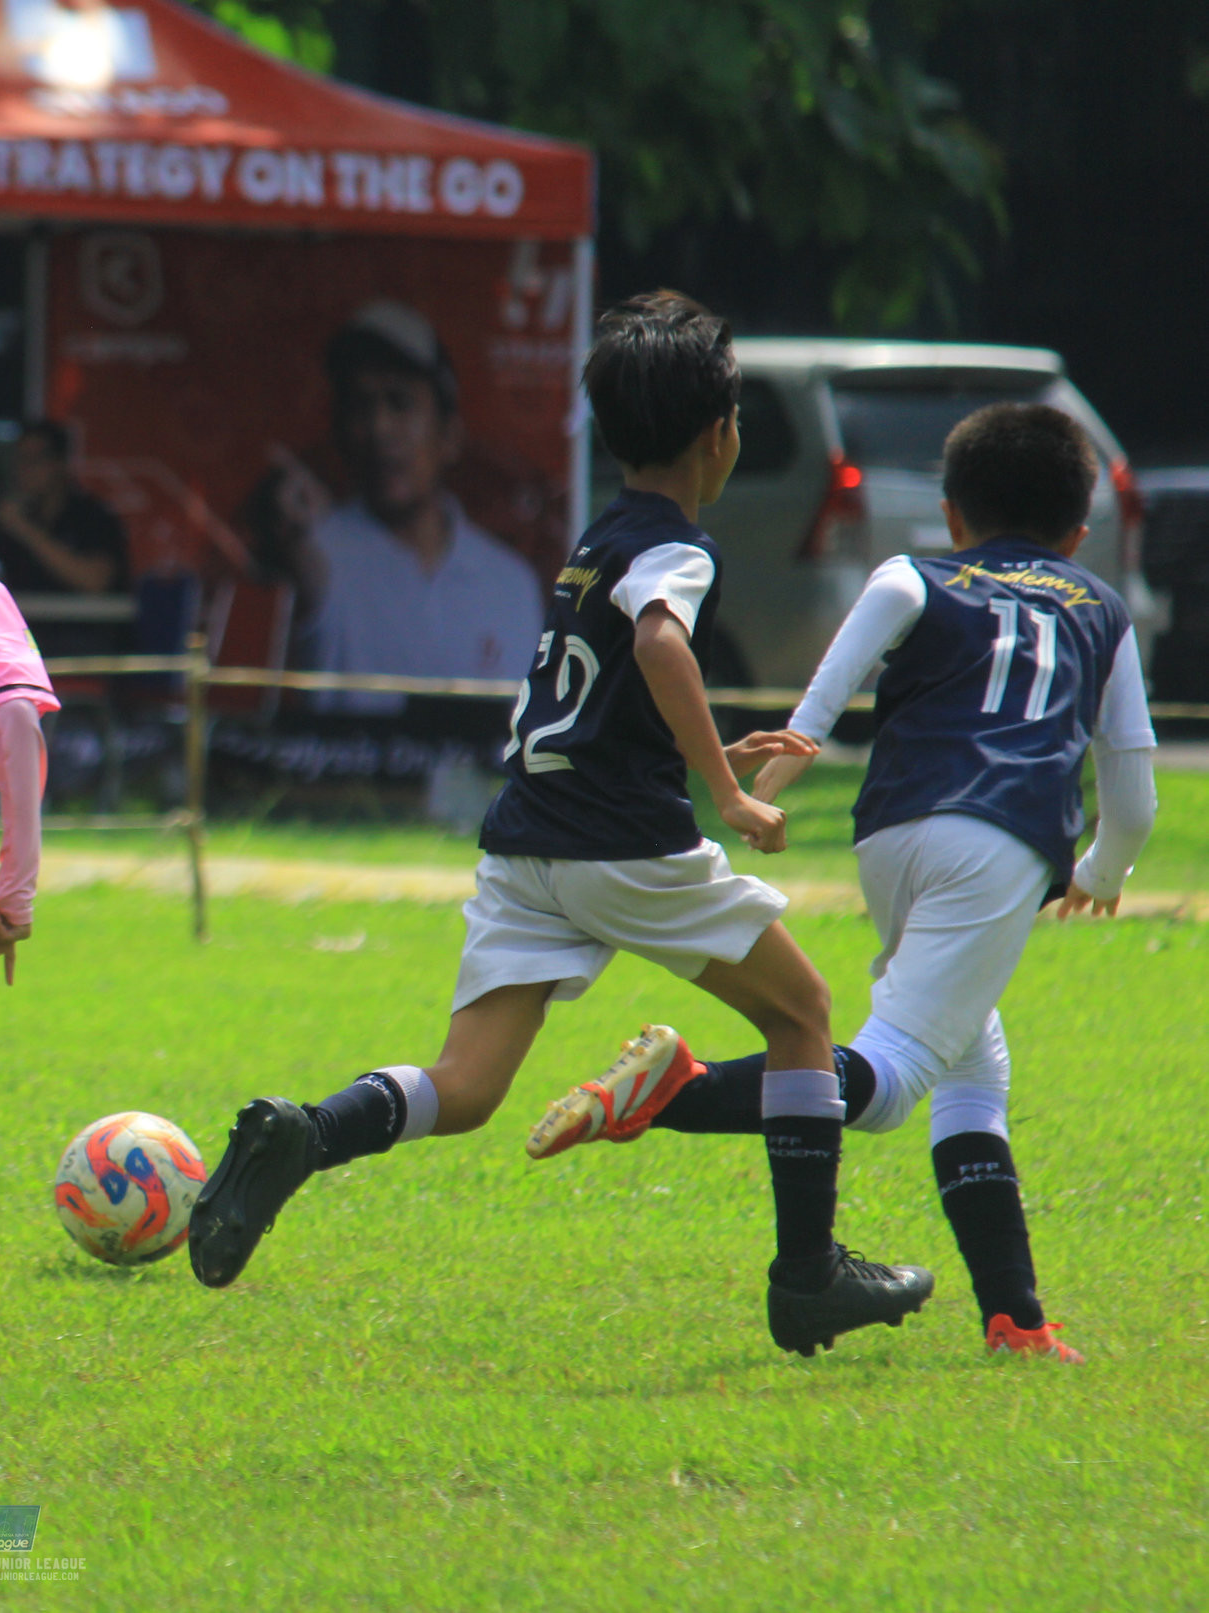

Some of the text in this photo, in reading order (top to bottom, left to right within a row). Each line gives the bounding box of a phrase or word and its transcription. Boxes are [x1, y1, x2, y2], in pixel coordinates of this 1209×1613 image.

[238, 147, 325, 203] ON
[333, 151, 433, 213] THE
[440, 158, 525, 217] GO
[981, 598, 1057, 721] 11
